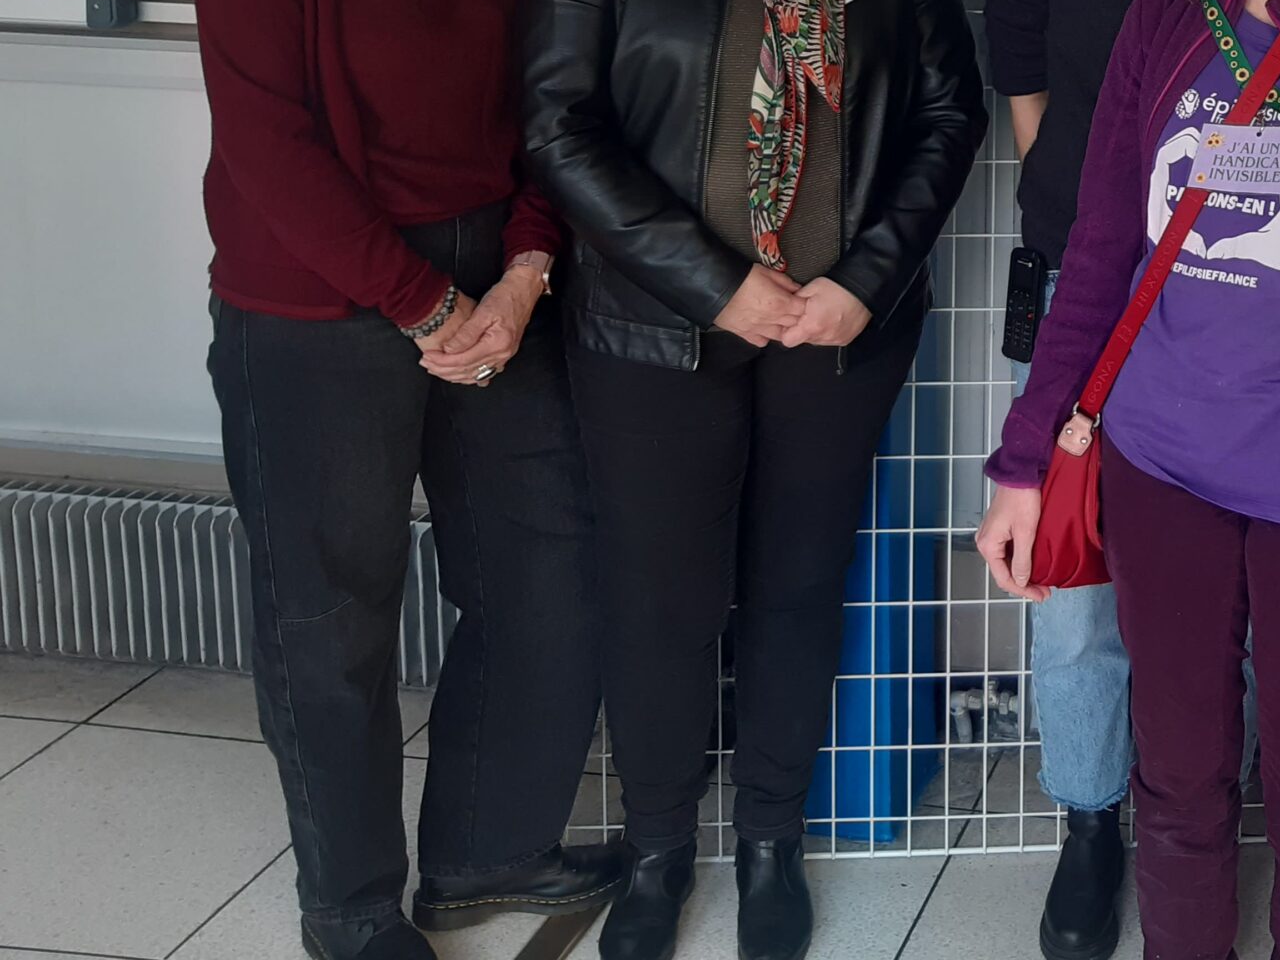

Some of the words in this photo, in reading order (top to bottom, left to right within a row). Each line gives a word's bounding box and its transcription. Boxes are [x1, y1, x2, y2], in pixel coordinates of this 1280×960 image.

[1226, 141, 1256, 154] J'AI
[1260, 142, 1280, 155] UN
[1171, 262, 1259, 288] EPILEPSIEFRANCE
